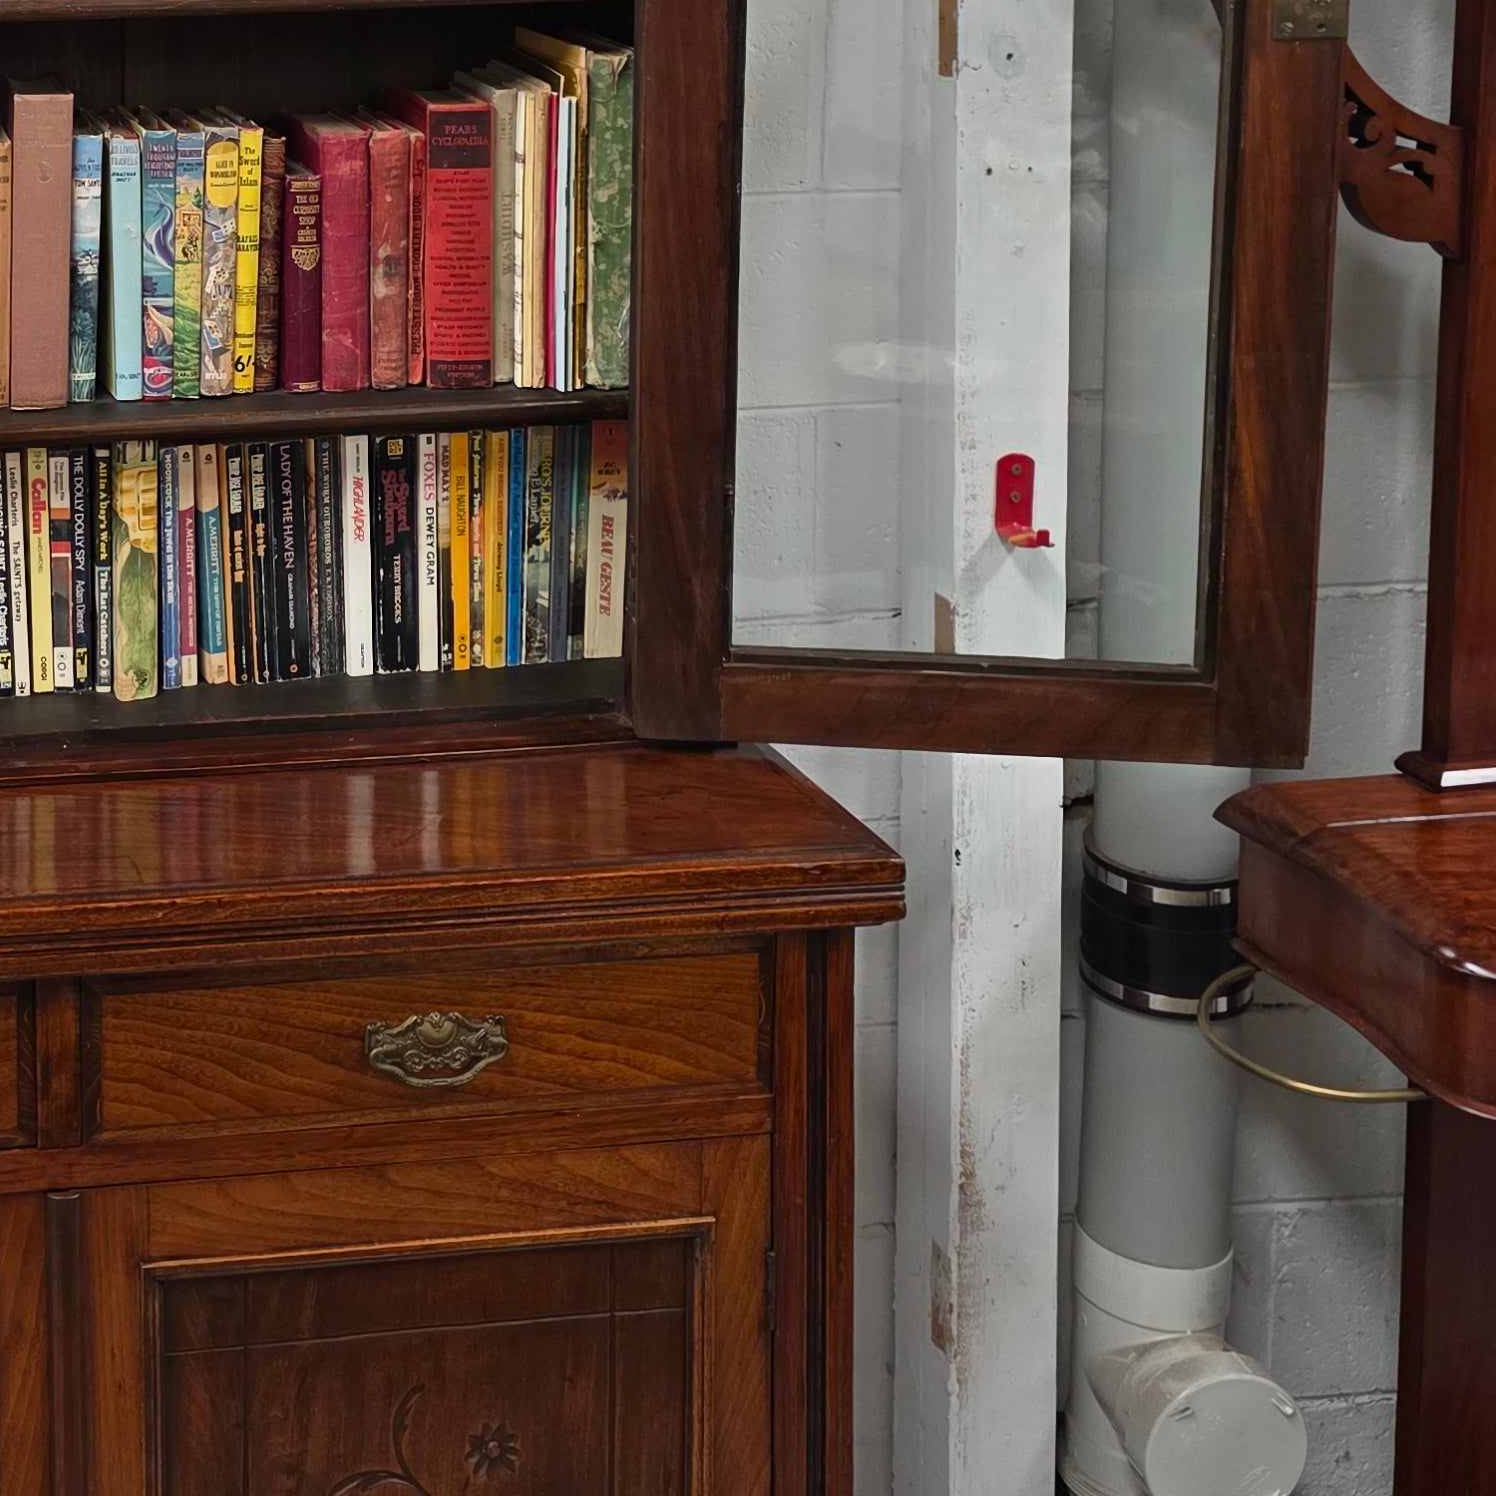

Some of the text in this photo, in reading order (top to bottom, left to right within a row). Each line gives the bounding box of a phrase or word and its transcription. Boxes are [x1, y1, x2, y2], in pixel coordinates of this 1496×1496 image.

[432, 135, 489, 146] CYCLOPAEDIA
[444, 125, 477, 134] PEARS
[31, 478, 46, 534] Callan
[73, 455, 85, 571] THE DOLLY DOLLY SPY
[350, 476, 367, 542] HIGHLANDER
[423, 452, 436, 586] FOXES DEWEY GRAM
[599, 514, 615, 616] BEAU GESTE
